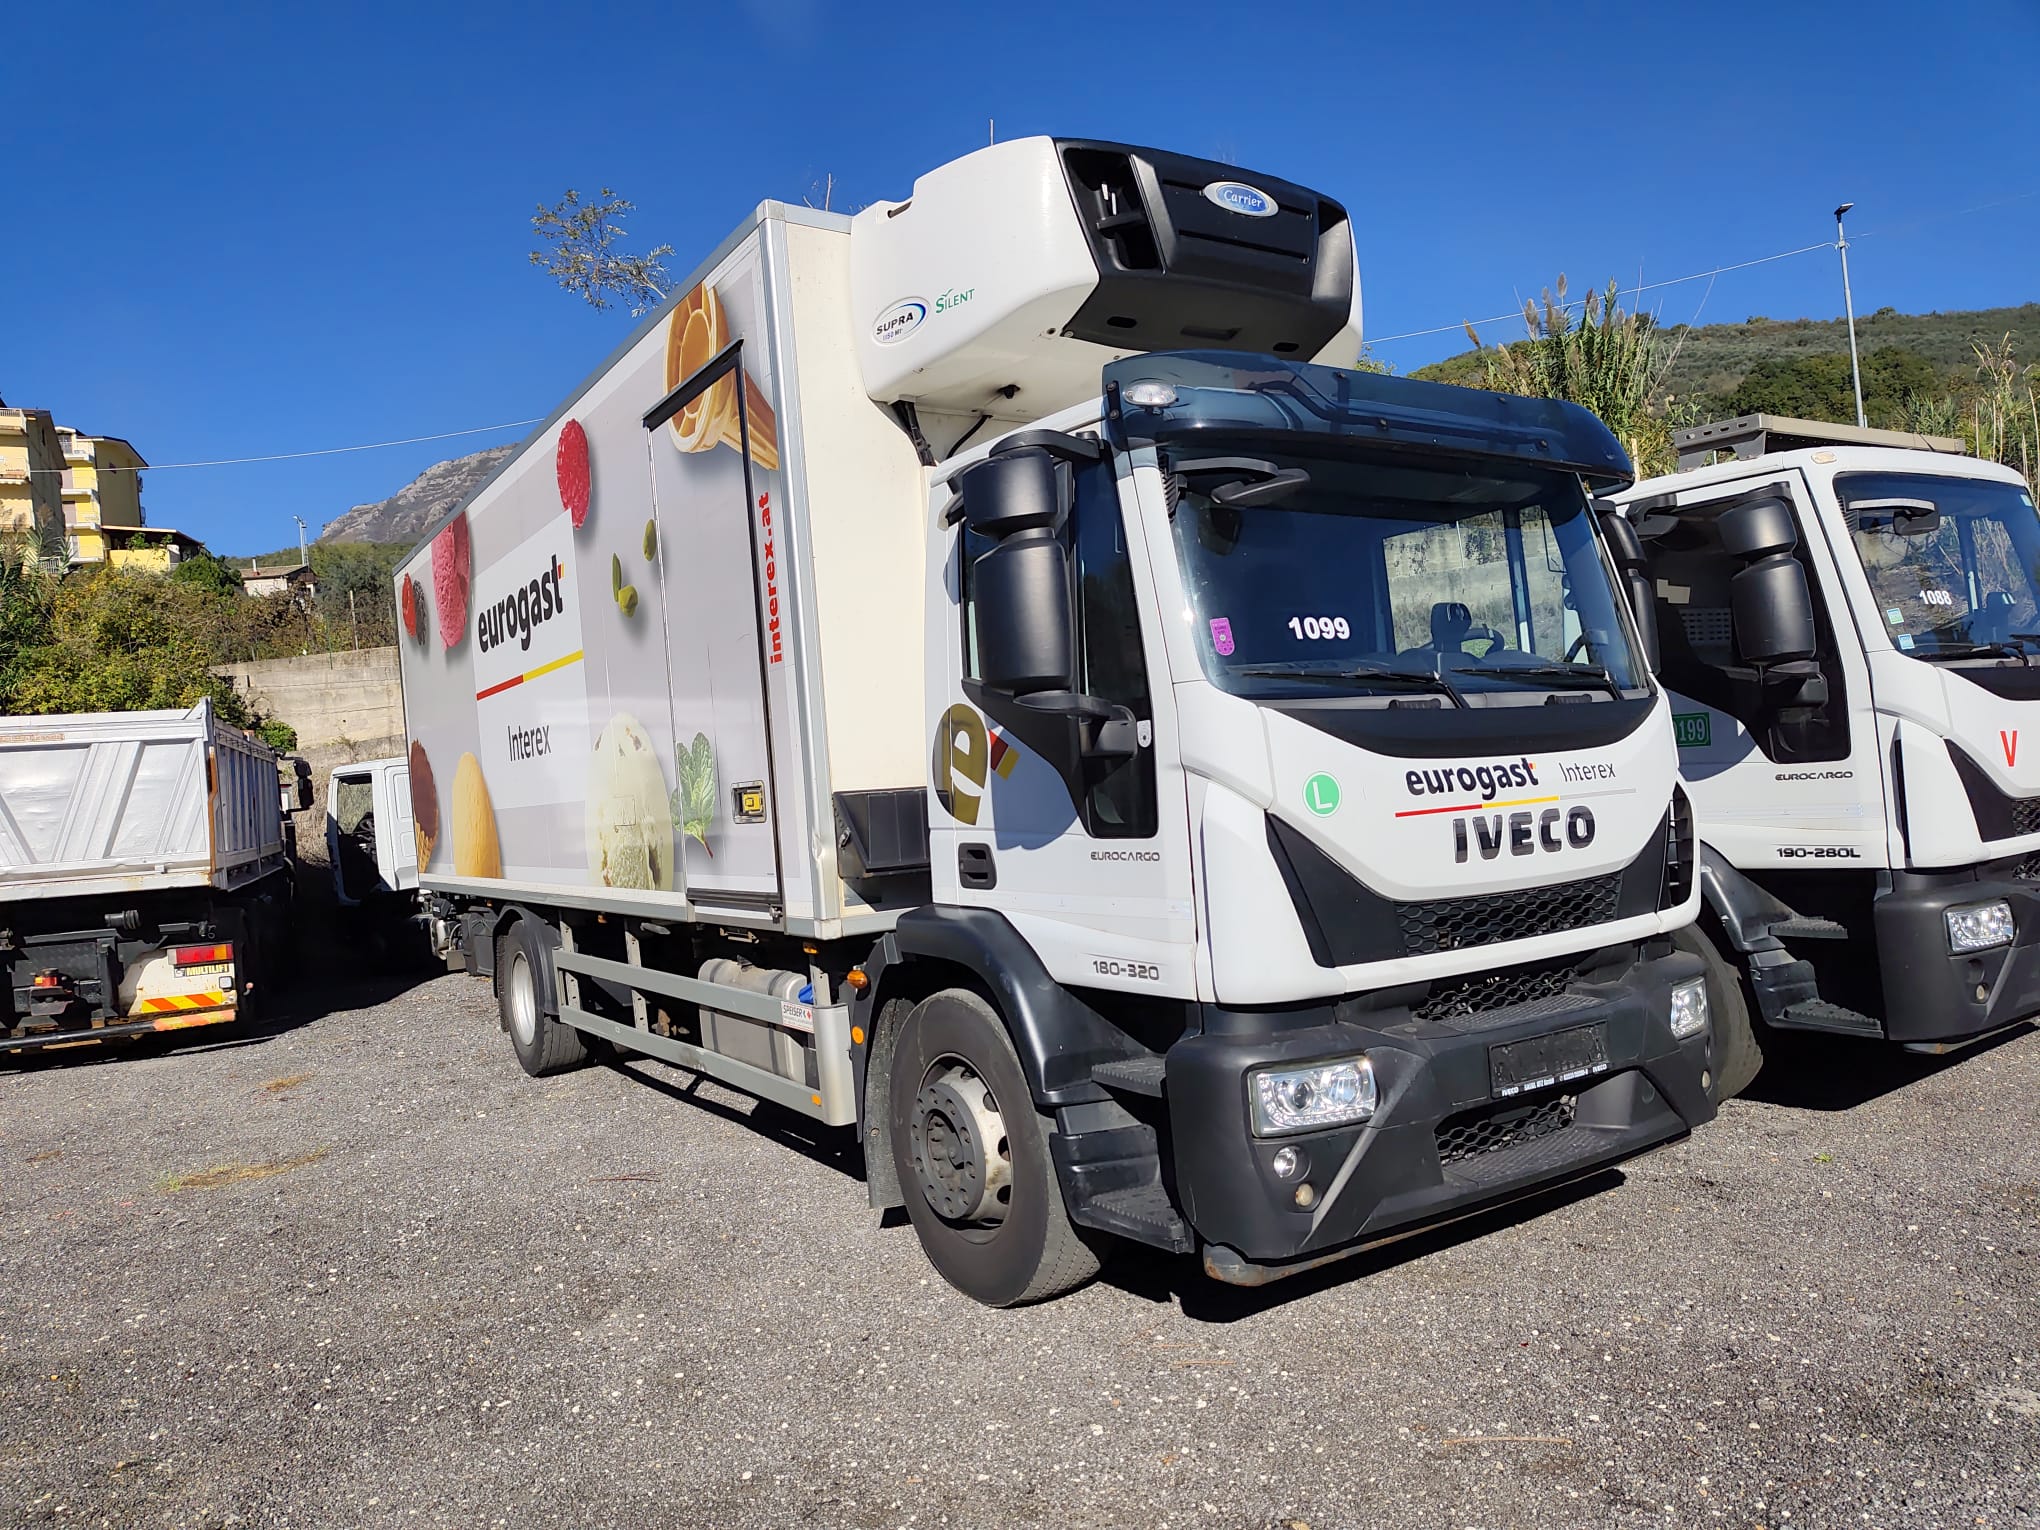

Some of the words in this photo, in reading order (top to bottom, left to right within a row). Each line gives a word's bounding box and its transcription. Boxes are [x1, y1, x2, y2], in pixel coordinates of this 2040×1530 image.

[1223, 189, 1263, 207] Carrier
[935, 288, 975, 313] SILENT
[876, 311, 914, 335] SUPRA
[758, 492, 783, 664] interex.at
[478, 553, 563, 653] eurogast
[1919, 590, 1953, 605] 1088
[1288, 616, 1351, 640] 1099
[507, 724, 552, 762] Interex
[1999, 730, 2018, 767] V
[1405, 757, 1539, 801] eurogast
[1559, 761, 1617, 783] Interex
[1775, 771, 1854, 780] EUROCARGO
[1312, 781, 1334, 810] L
[1452, 805, 1596, 864] IVECO
[1090, 851, 1161, 862] EUROCARGO
[1776, 847, 1861, 858] 190-280L
[1092, 961, 1160, 981] 180-320
